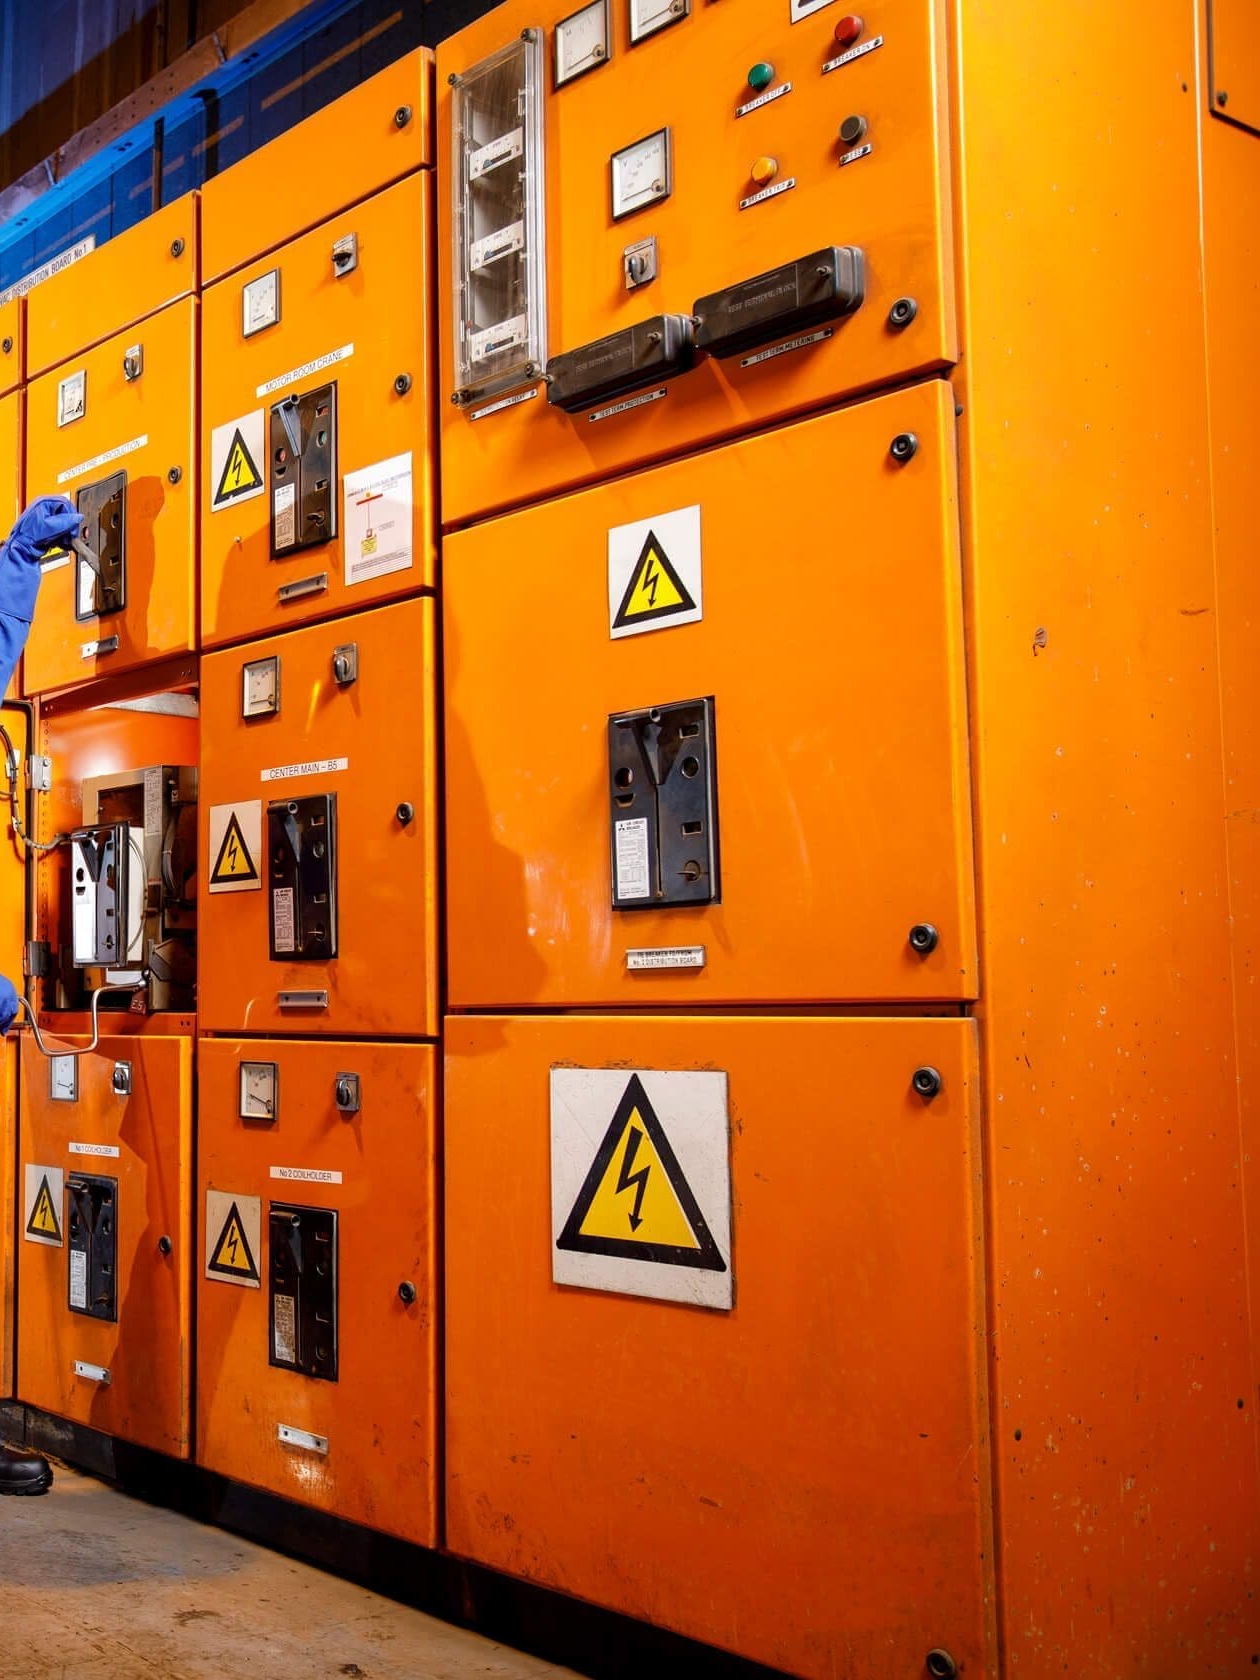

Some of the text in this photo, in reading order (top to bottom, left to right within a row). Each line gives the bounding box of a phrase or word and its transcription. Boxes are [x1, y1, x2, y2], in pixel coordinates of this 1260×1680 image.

[11, 267, 49, 298] DISTRIBUTION
[51, 253, 72, 275] BOARD
[265, 349, 344, 392] MOTOR ROOM CRANE
[269, 765, 299, 779] CENTER
[300, 763, 320, 774] MAIN
[280, 1168, 287, 1177] No
[293, 1170, 332, 1181] COILHOLDER
